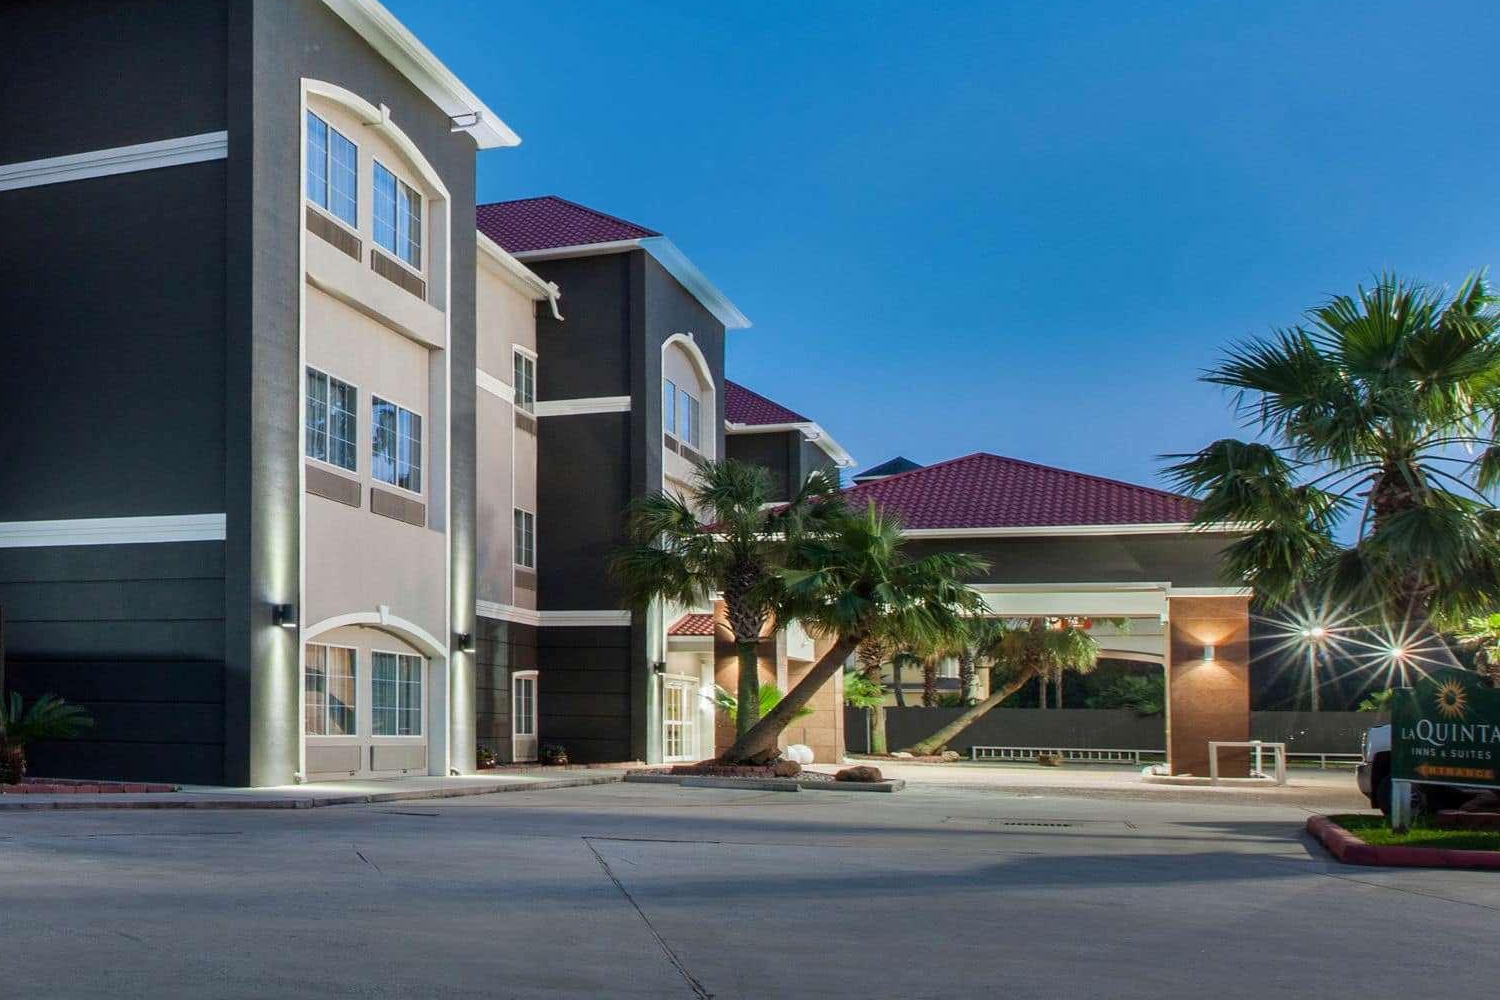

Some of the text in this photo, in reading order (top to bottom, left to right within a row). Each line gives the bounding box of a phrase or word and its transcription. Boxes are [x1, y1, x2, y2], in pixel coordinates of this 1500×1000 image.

[1402, 718, 1500, 747] LA QUINTA
[1450, 749, 1492, 760] SUITES
